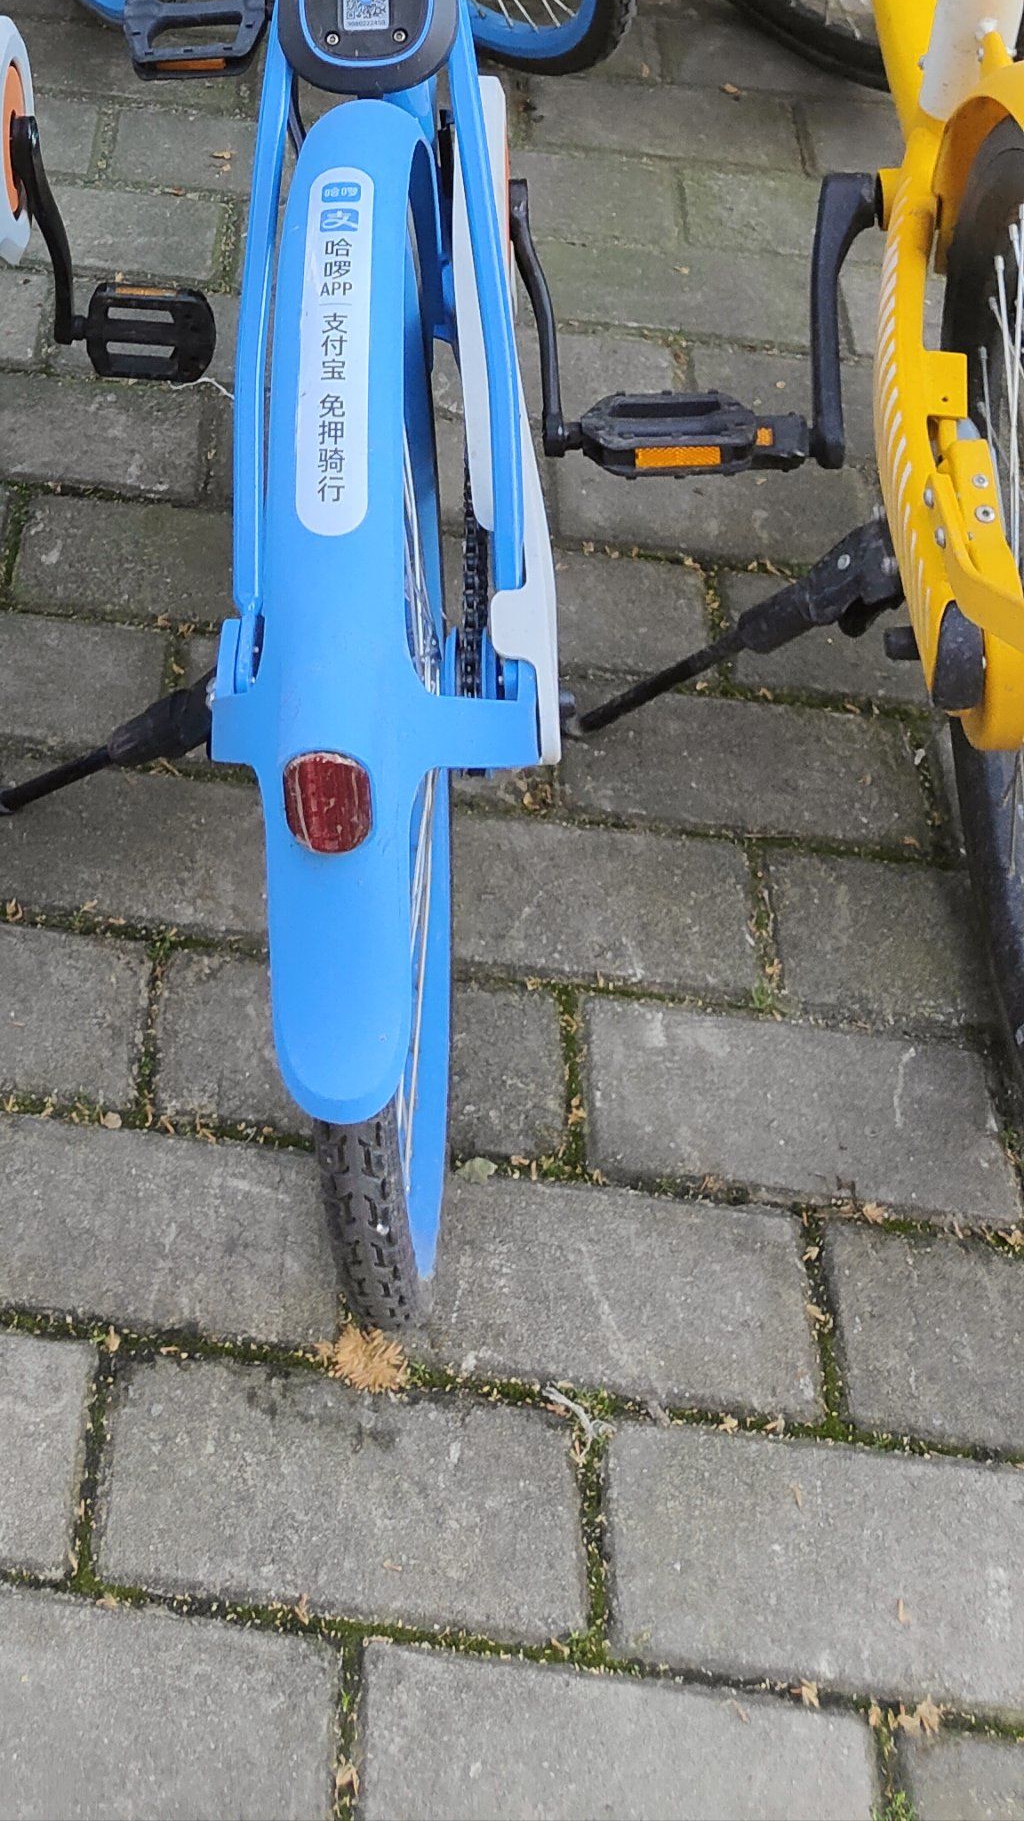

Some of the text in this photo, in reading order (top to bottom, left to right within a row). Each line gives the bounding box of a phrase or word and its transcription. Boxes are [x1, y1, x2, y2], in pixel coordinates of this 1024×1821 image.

[317, 312, 348, 503] 支付宝 免押骑行
